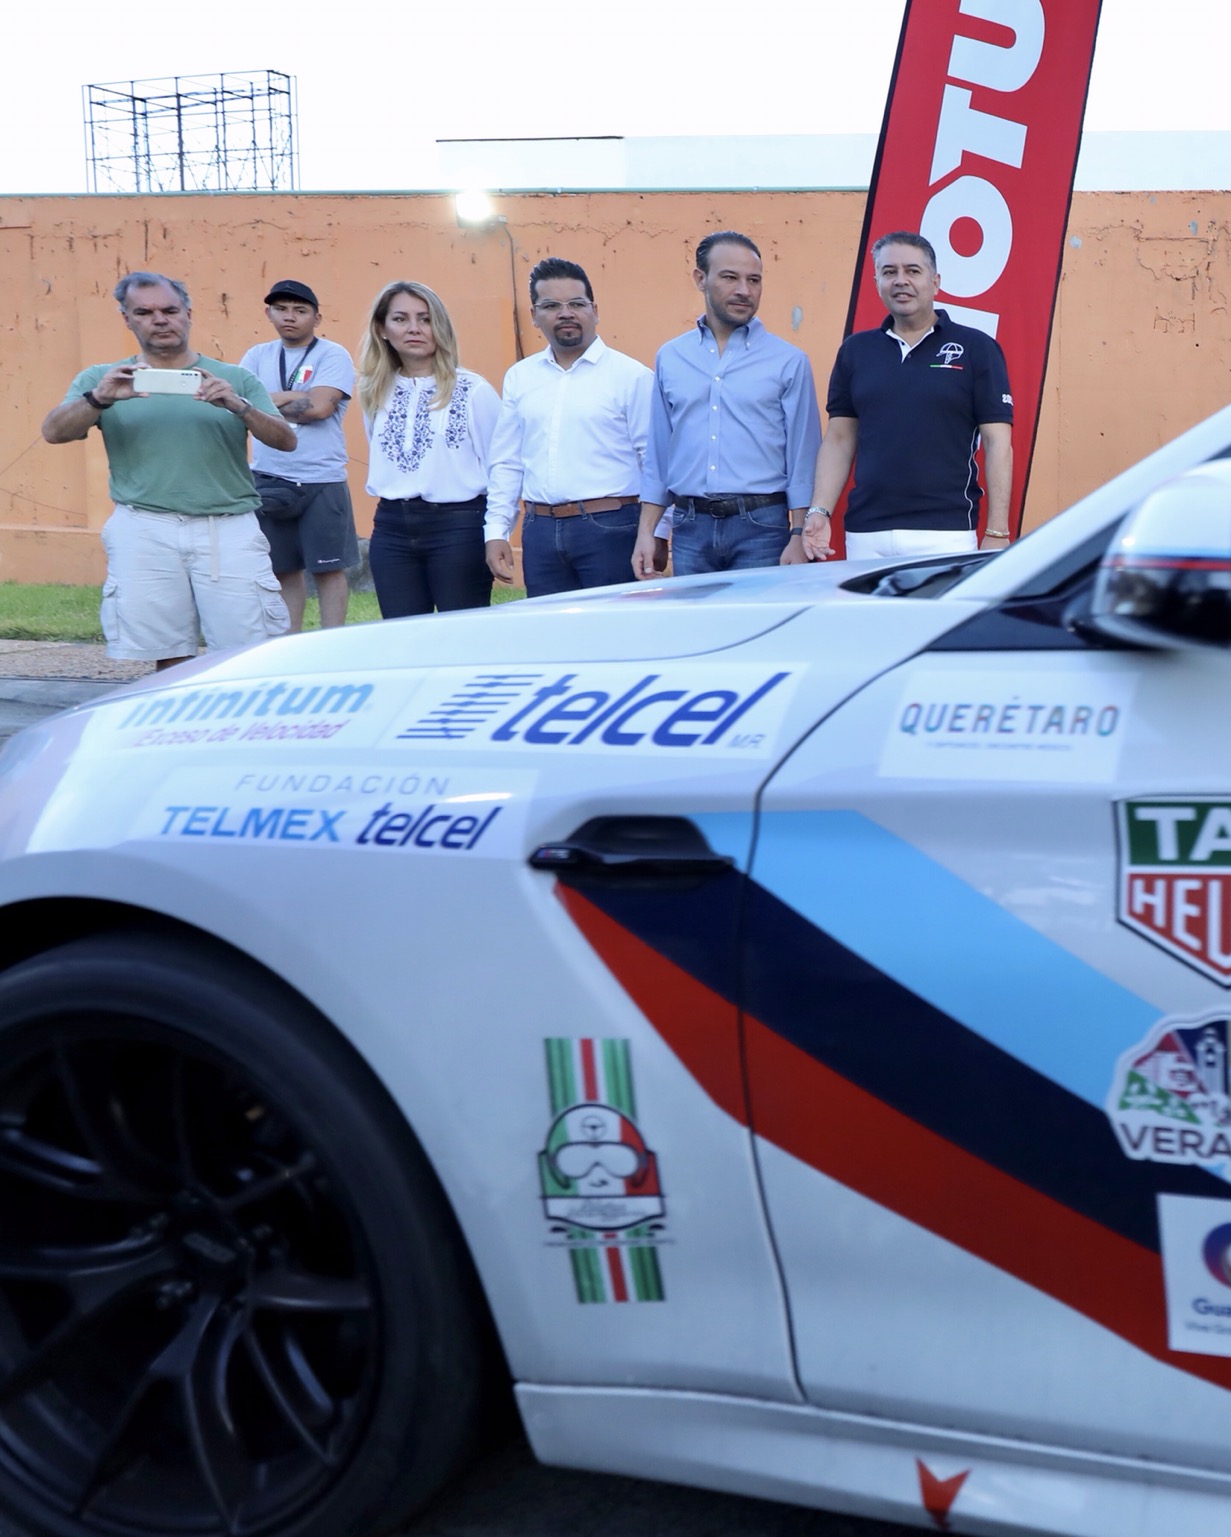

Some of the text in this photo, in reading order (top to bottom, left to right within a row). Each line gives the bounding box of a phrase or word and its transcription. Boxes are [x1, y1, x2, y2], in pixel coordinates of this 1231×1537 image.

[490, 671, 792, 747] telcel
[899, 696, 1120, 737] QUERÉTARO
[206, 724, 240, 742] de
[240, 719, 351, 741] Velocidad
[234, 773, 451, 796] FUNDACIÓN
[160, 803, 503, 850] TELMEX telcel
